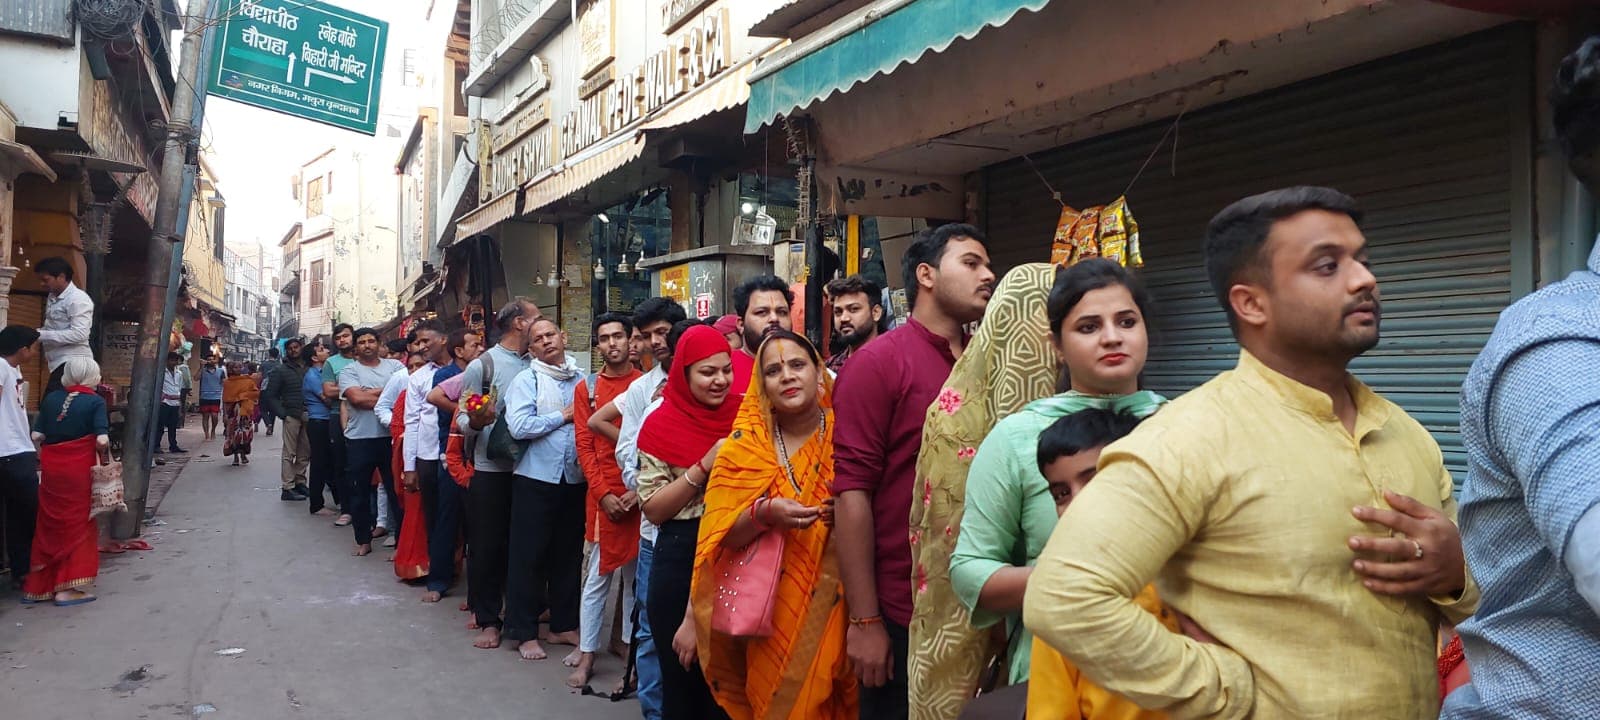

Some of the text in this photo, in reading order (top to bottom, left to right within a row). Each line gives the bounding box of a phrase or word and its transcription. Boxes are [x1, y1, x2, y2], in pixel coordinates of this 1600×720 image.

[242, 25, 288, 55] चौराहा
[301, 41, 367, 79] बिहारी जी मन्दिर
[247, 80, 270, 92] नगर
